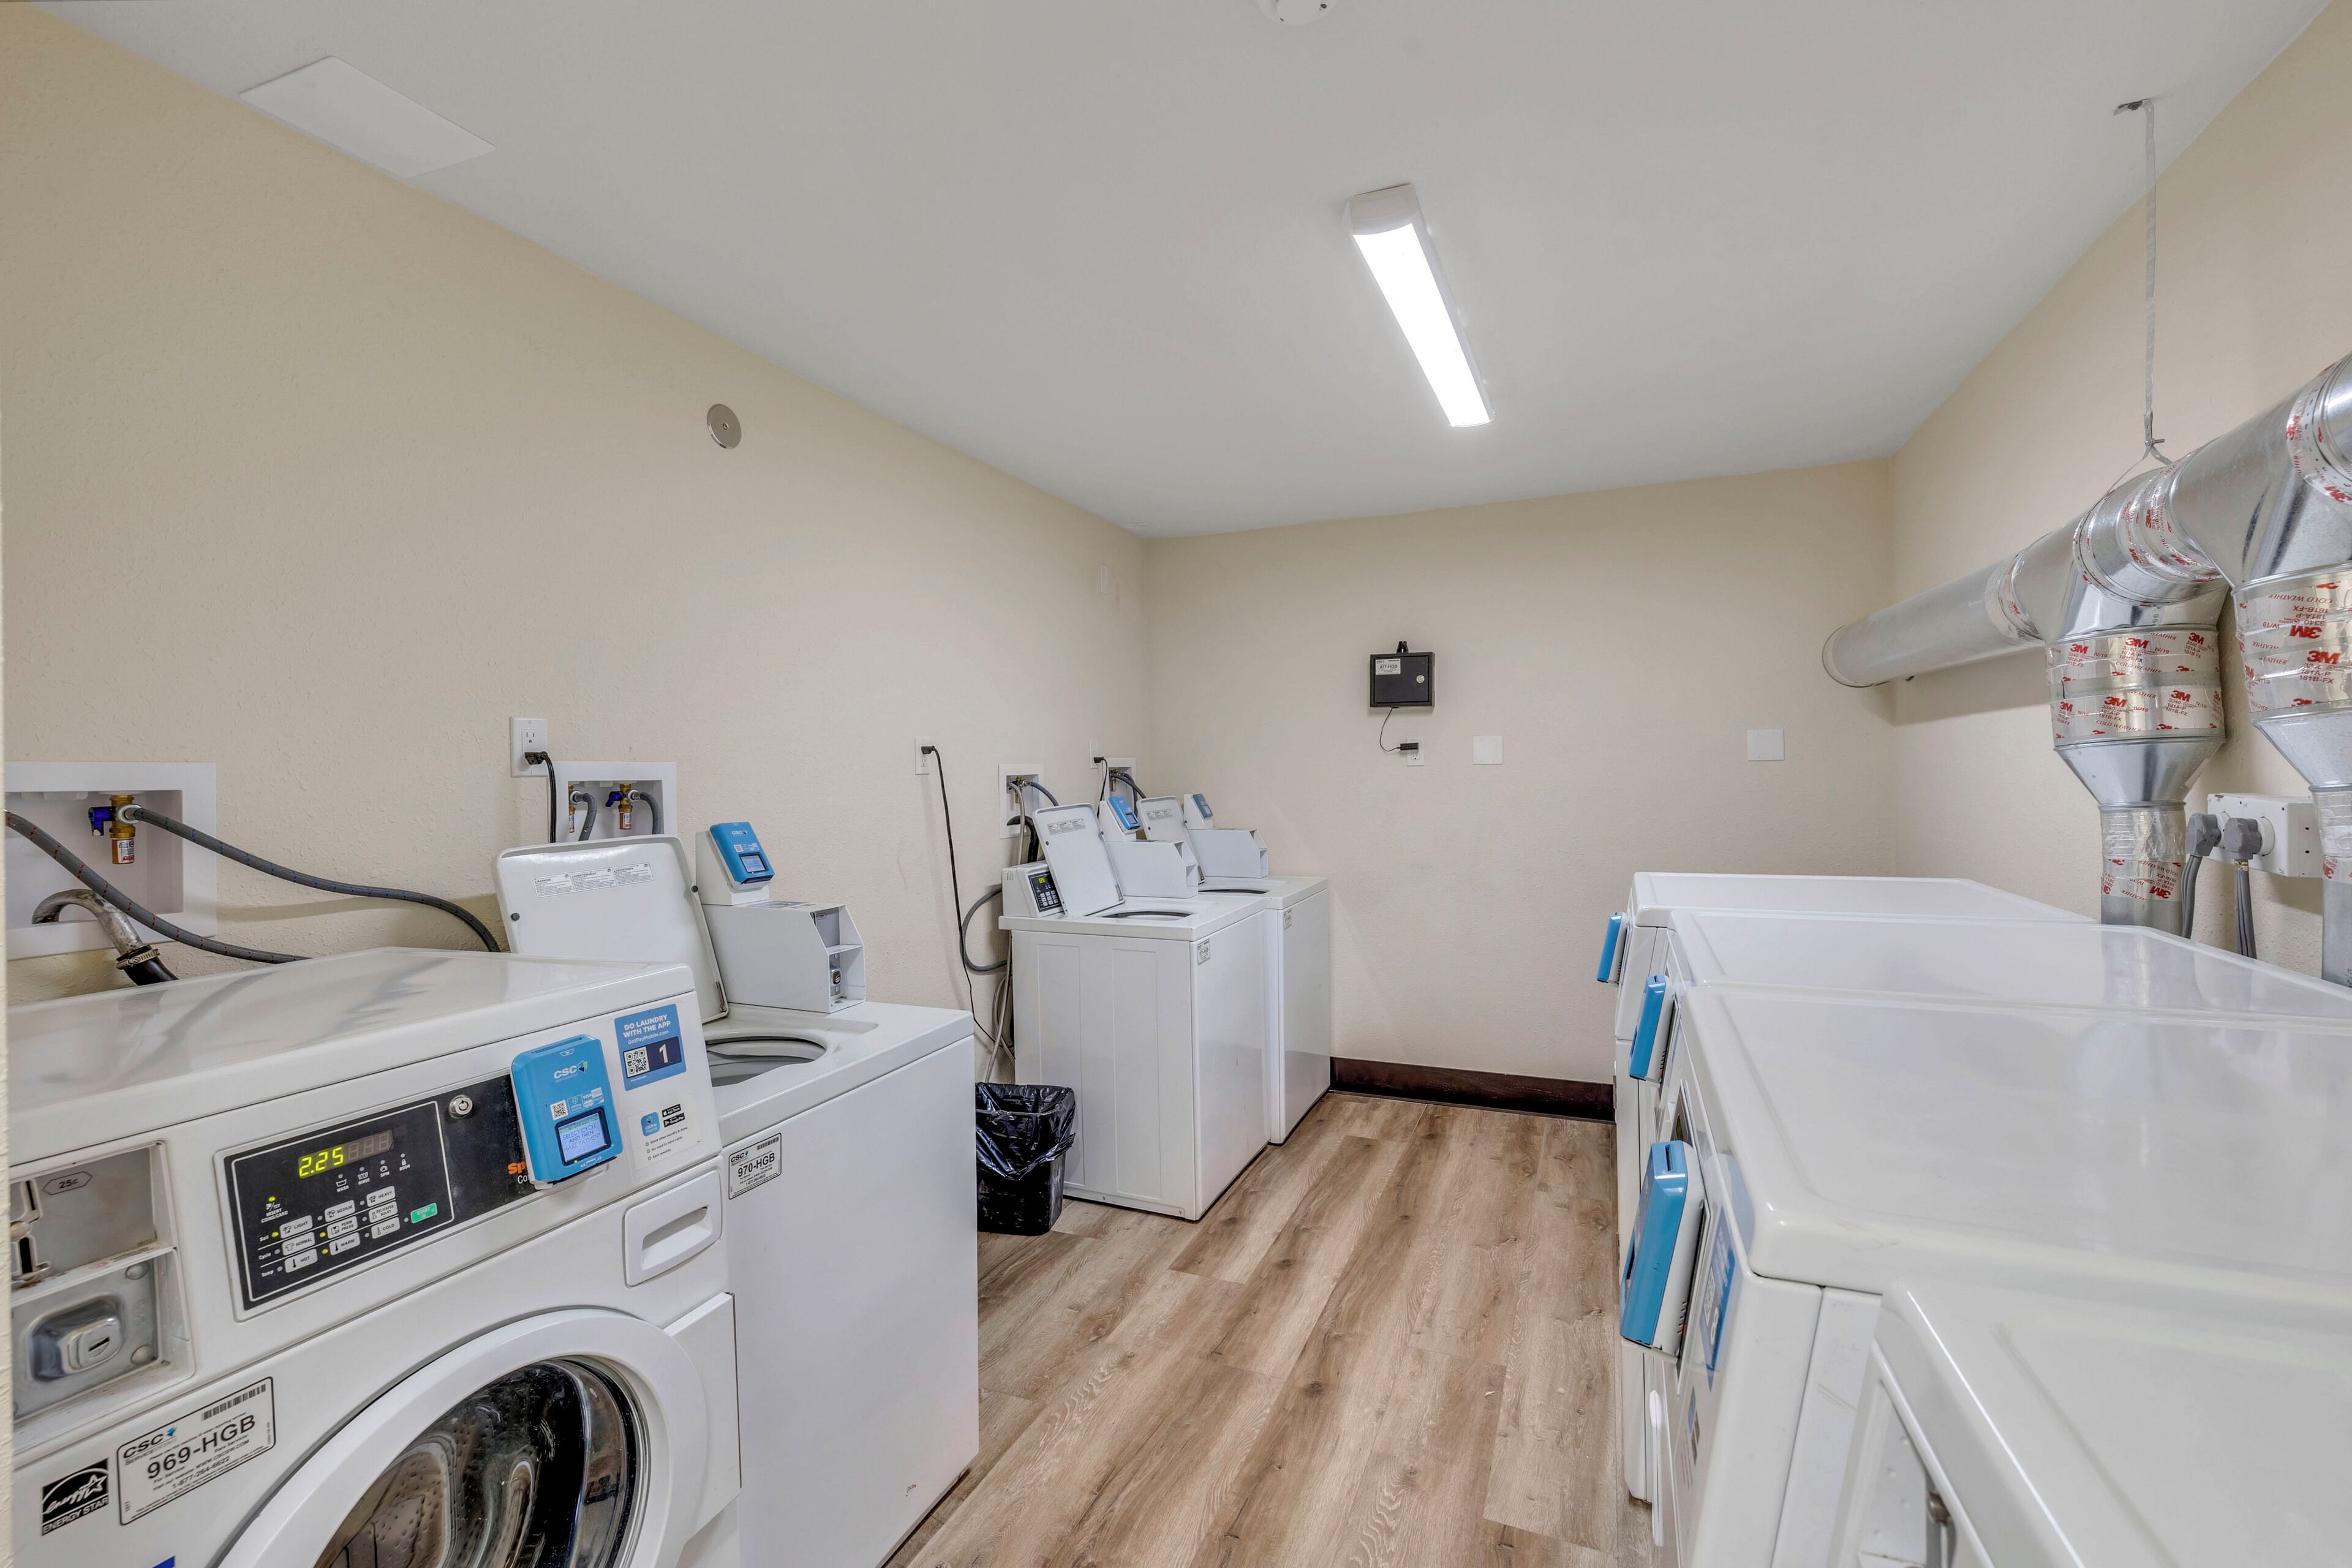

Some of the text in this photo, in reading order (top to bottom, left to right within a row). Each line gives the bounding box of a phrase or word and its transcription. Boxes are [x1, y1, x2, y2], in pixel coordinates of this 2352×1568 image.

[2146, 510, 2152, 529] 3M
[2188, 632, 2204, 645] 3M
[2289, 625, 2322, 639] 3M
[2070, 644, 2089, 654] 3M
[2125, 638, 2149, 649] 3M
[2307, 650, 2340, 665] 3M
[2299, 675, 2335, 684] 181B-FX
[2104, 696, 2127, 707] 3M
[2171, 690, 2191, 702] 3M
[2060, 701, 2073, 712] 3M
[2165, 707, 2188, 716] 181B-FX
[2149, 886, 2171, 899] 3M
[636, 1014, 668, 1027] LAUNDRY
[623, 1020, 671, 1038] WITH THE APP
[628, 1030, 669, 1044] GetPayMobile.com
[659, 1044, 668, 1063] 1
[554, 1065, 577, 1079] CSC
[564, 1129, 579, 1140] SELECT
[299, 1146, 344, 1177] 2.25
[508, 1161, 526, 1175] Sp
[737, 1153, 775, 1177] 970-HGB
[518, 1175, 528, 1184] Co
[266, 1208, 282, 1216] INSERT
[337, 1205, 353, 1213] MEDIUM
[123, 1433, 163, 1458] CSC
[148, 1415, 255, 1479] 969-HGB
[43, 1509, 82, 1534] ENERGY
[83, 1497, 108, 1515] STAR
